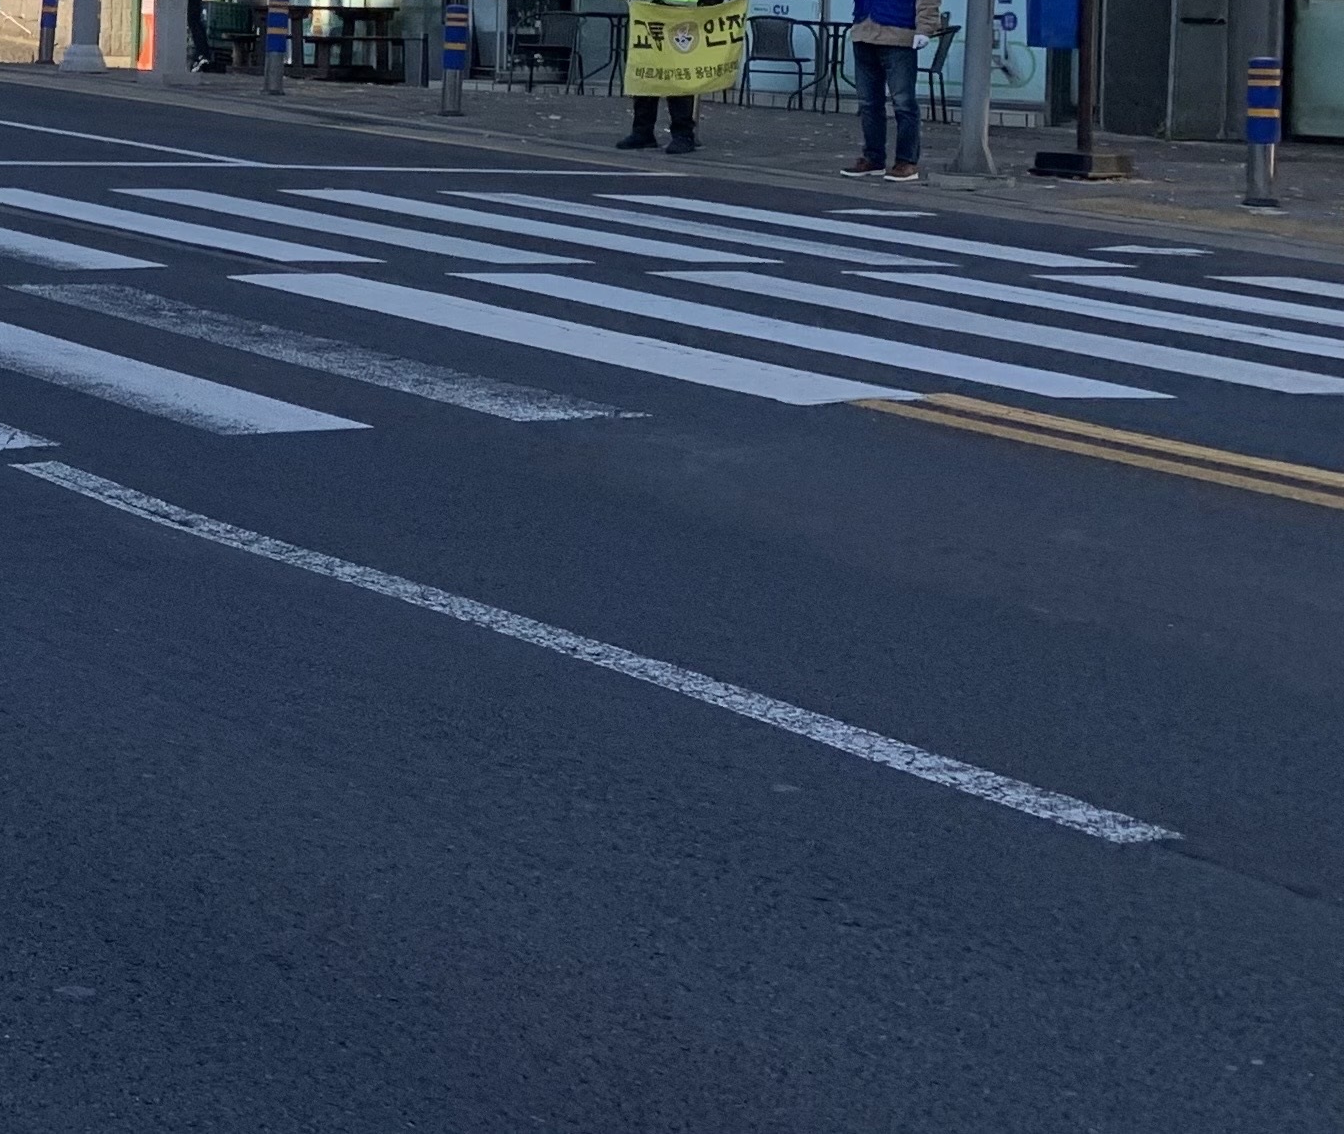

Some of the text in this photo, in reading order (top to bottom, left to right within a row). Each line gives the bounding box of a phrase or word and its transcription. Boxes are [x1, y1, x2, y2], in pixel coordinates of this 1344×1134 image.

[773, 4, 790, 15] CU
[633, 13, 746, 52] 교통 안전
